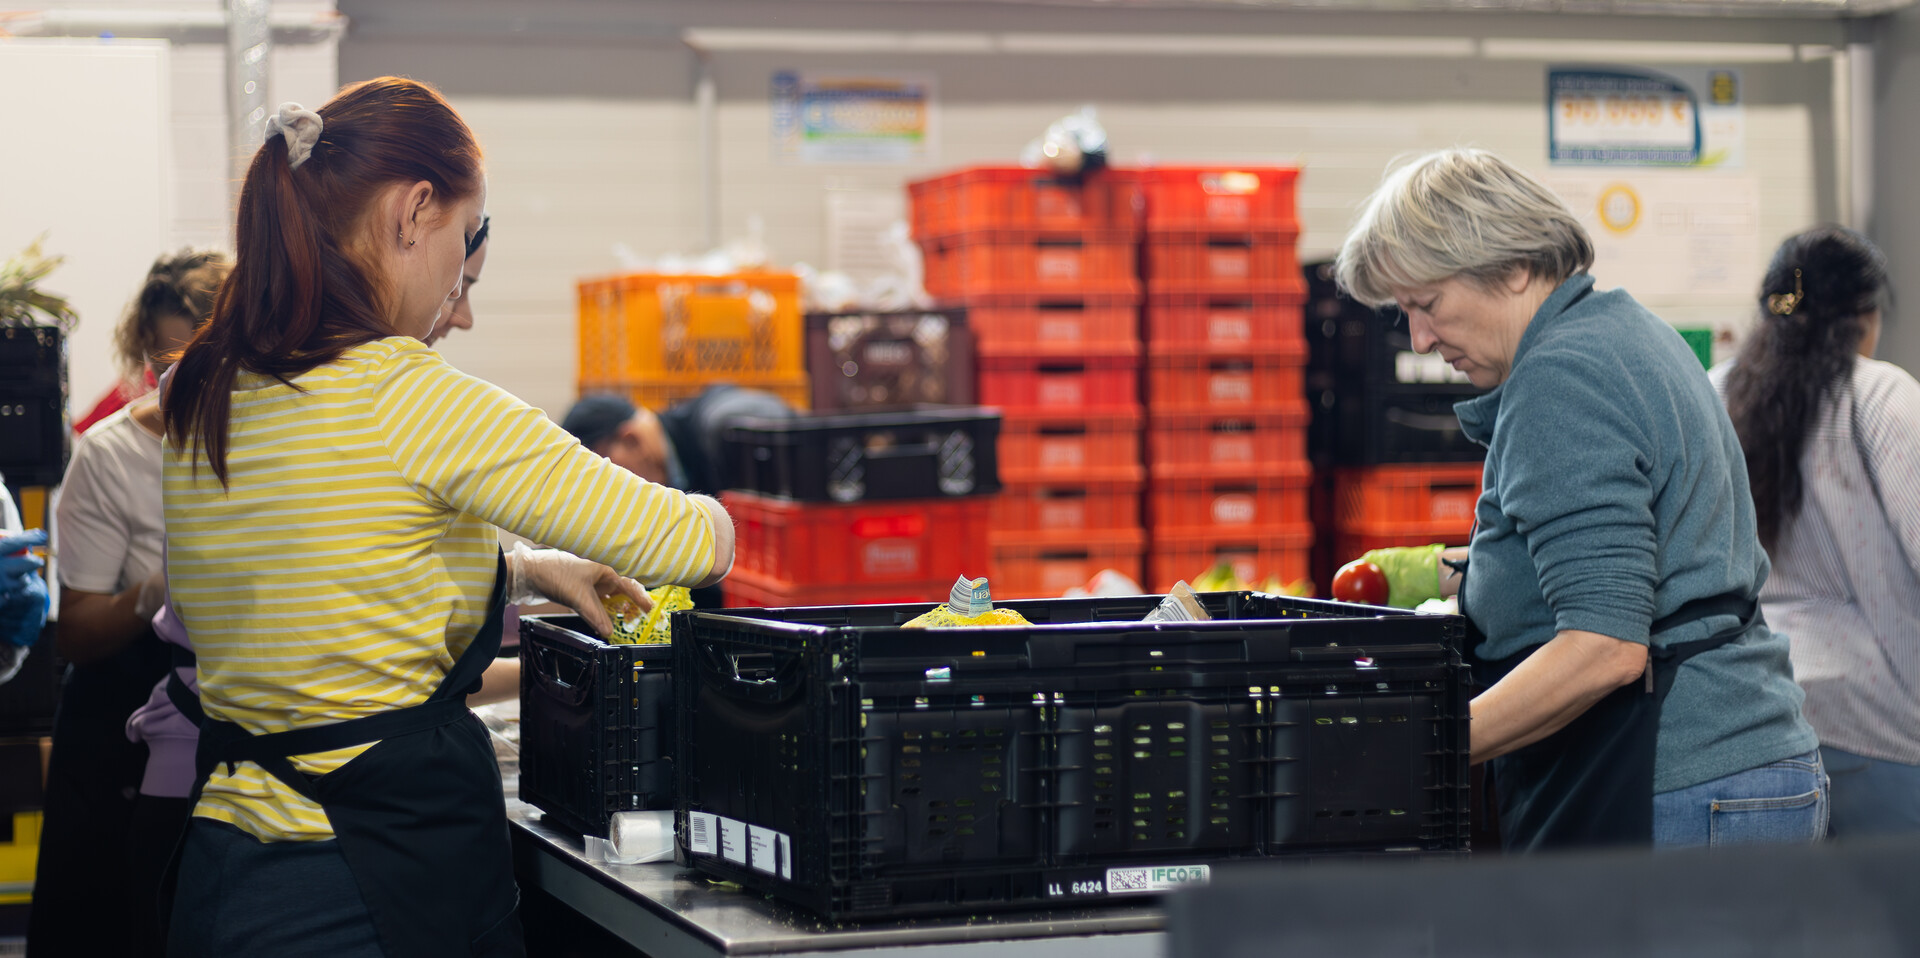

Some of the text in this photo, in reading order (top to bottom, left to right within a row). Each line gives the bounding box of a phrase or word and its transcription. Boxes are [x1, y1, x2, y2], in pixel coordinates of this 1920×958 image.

[1151, 868, 1188, 881] IFCO
[1049, 881, 1102, 895] LL 6424
